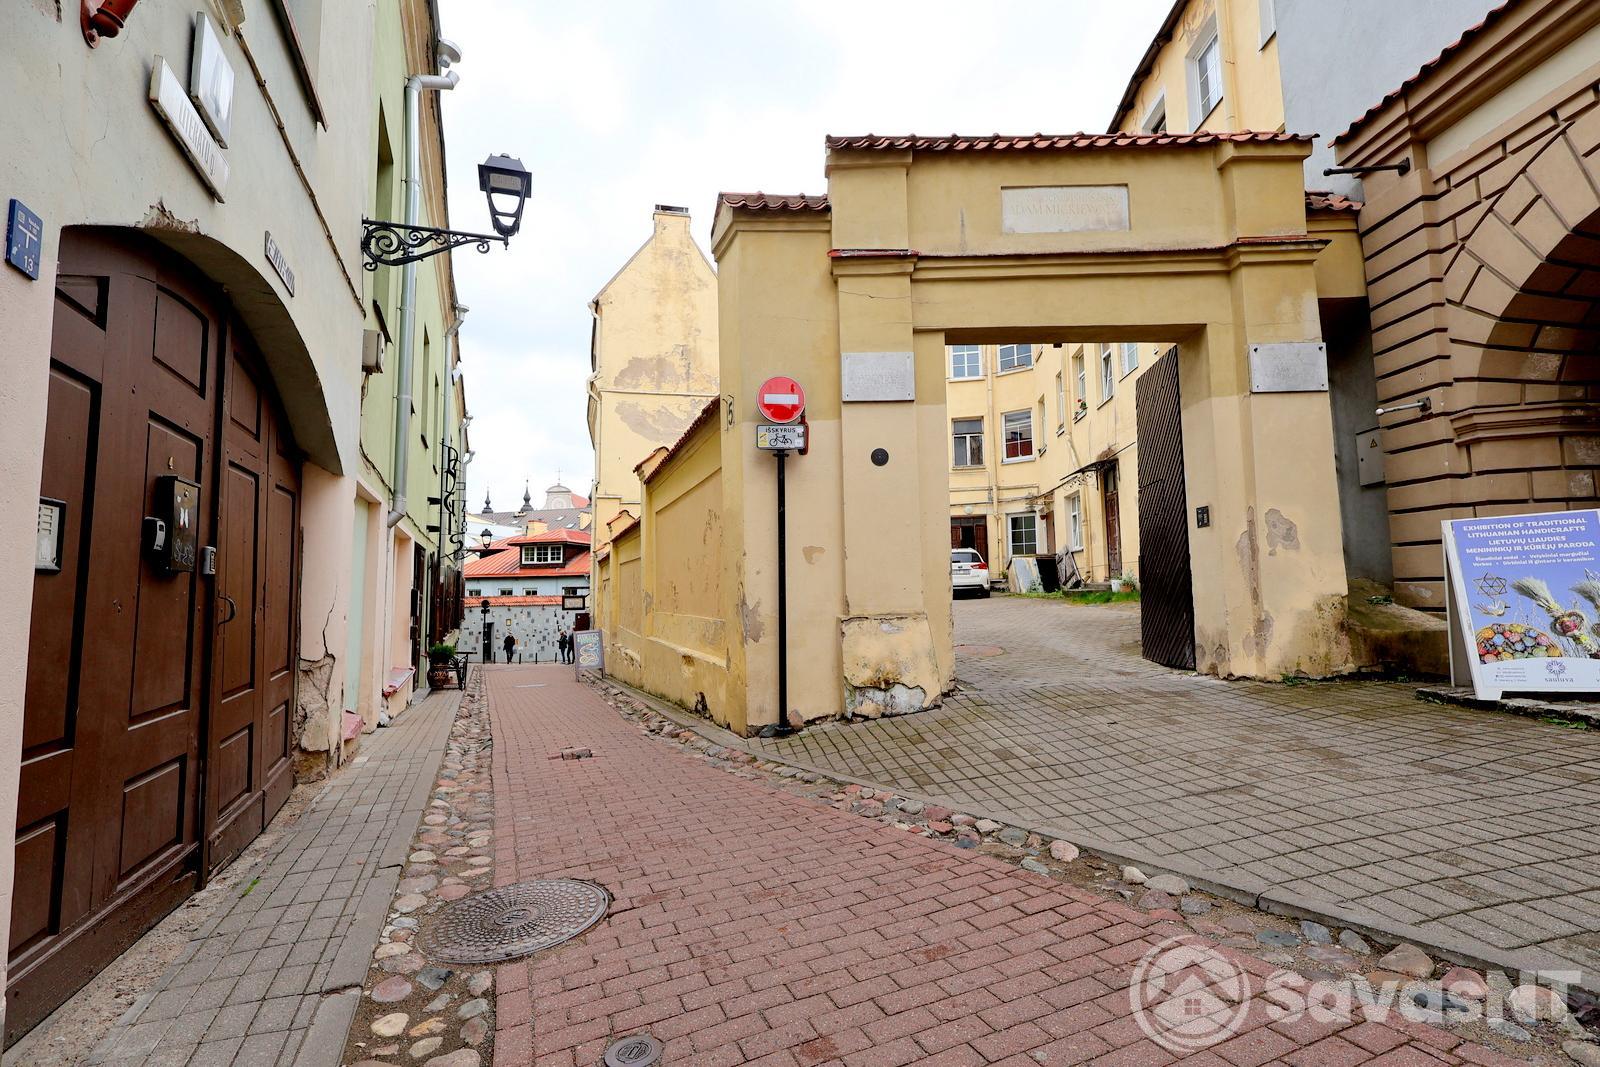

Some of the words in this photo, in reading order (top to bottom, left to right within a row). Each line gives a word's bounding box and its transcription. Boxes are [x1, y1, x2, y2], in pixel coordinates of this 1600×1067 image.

[24, 255, 34, 272] 13
[1463, 522, 1511, 531] EXHIBITION
[1526, 517, 1588, 527] TRADITIONAL
[1467, 530, 1520, 538] LITHUANIAN
[1521, 525, 1586, 535] HANDICRAFTS
